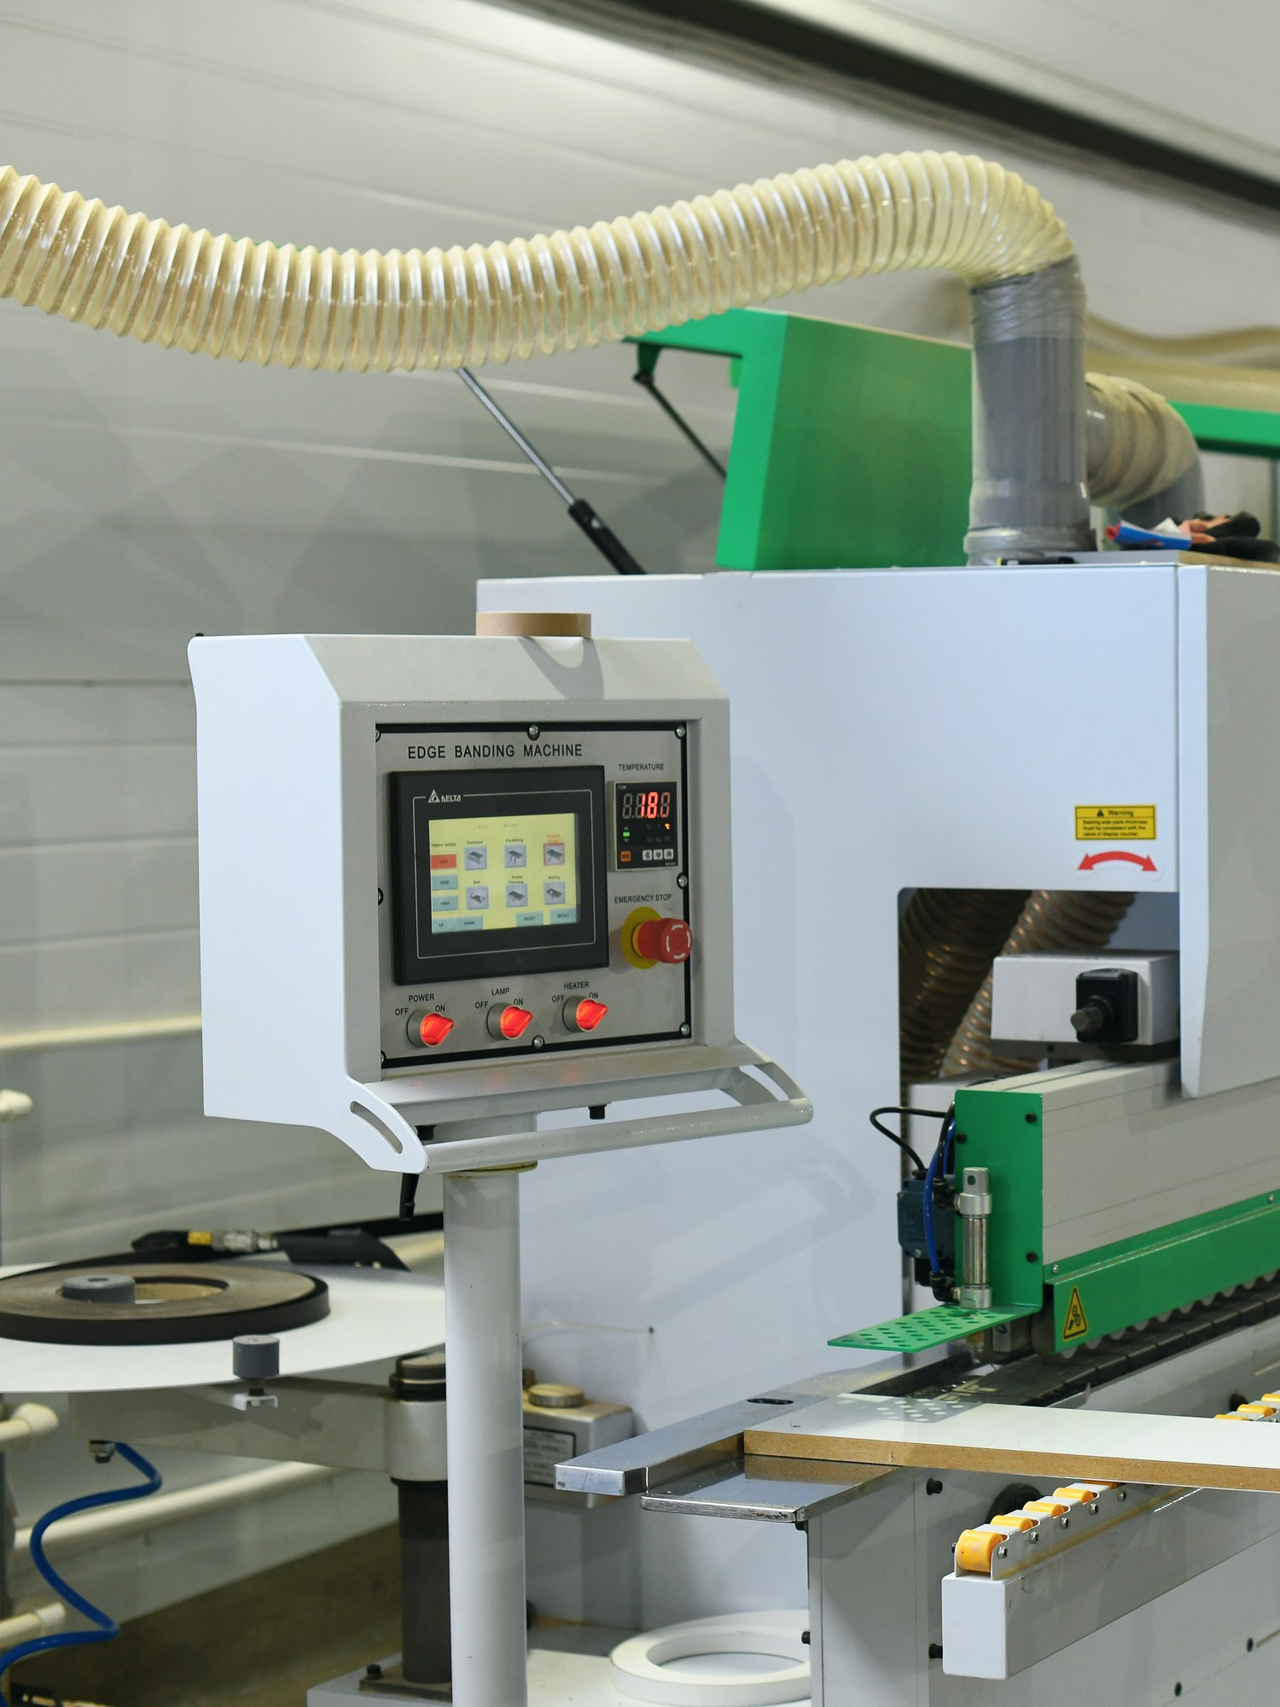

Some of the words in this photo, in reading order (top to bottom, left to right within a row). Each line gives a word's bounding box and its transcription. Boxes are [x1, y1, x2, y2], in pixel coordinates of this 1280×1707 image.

[408, 745, 446, 759] EDGE
[454, 744, 515, 758] BANDING
[523, 744, 582, 757] MACHINE
[618, 763, 665, 771] TEMPERATURE
[441, 793, 461, 803] DELTA
[614, 894, 654, 904] EMERGENCY
[655, 893, 672, 902] STOP
[563, 981, 590, 990] HEATER
[491, 987, 510, 996] LAMP
[408, 993, 435, 1003] POWER
[513, 998, 523, 1006] ON
[551, 994, 565, 1003] OFF
[434, 1004, 446, 1012] ON
[474, 1001, 488, 1009] OFF
[394, 1007, 409, 1016] OFF
